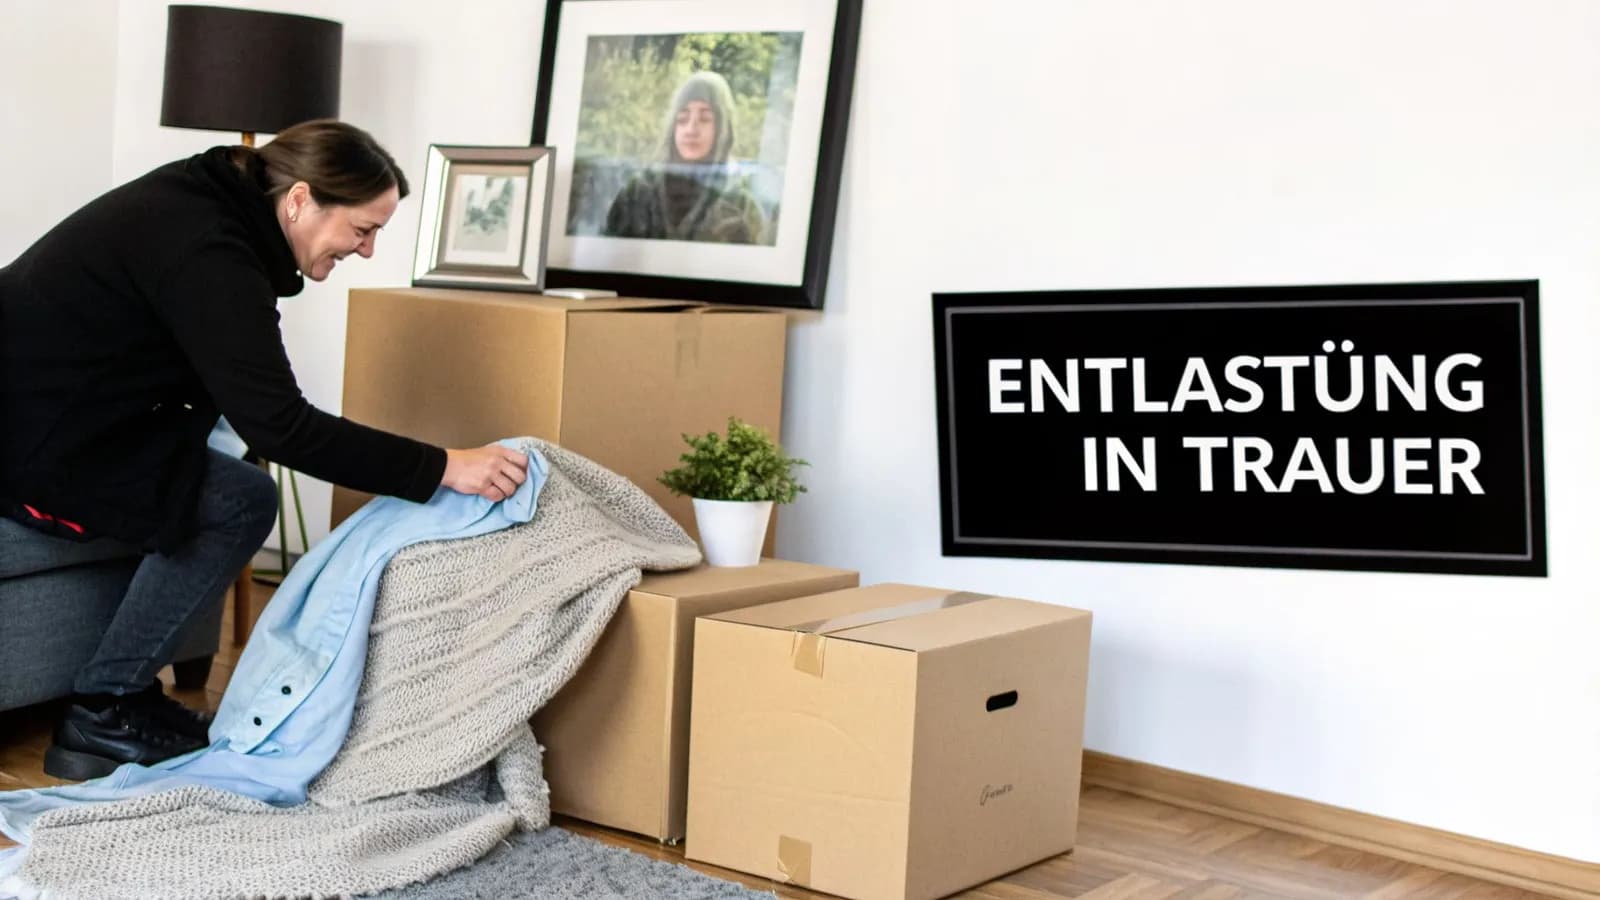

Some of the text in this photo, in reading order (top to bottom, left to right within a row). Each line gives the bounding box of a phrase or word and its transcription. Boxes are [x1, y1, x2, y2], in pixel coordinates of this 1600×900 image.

[988, 339, 1485, 414] ENTLASTÜNG
[1083, 437, 1485, 495] IN TRAUER
